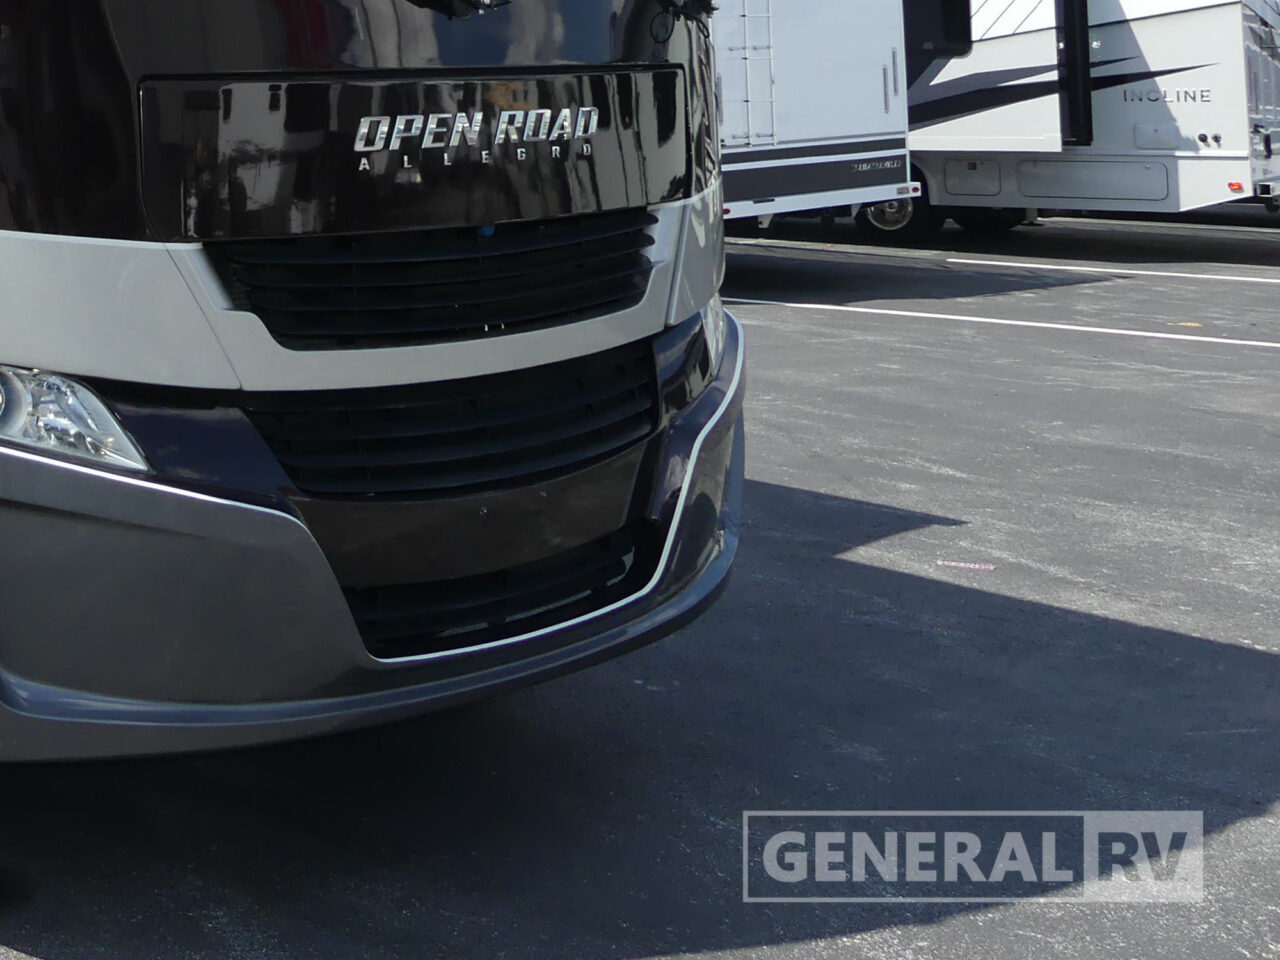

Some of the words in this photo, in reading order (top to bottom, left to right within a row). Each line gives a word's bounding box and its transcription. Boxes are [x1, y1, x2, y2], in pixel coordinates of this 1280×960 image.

[1123, 89, 1212, 103] INCLINE
[353, 111, 484, 153] OPEN
[493, 106, 600, 145] ROAD
